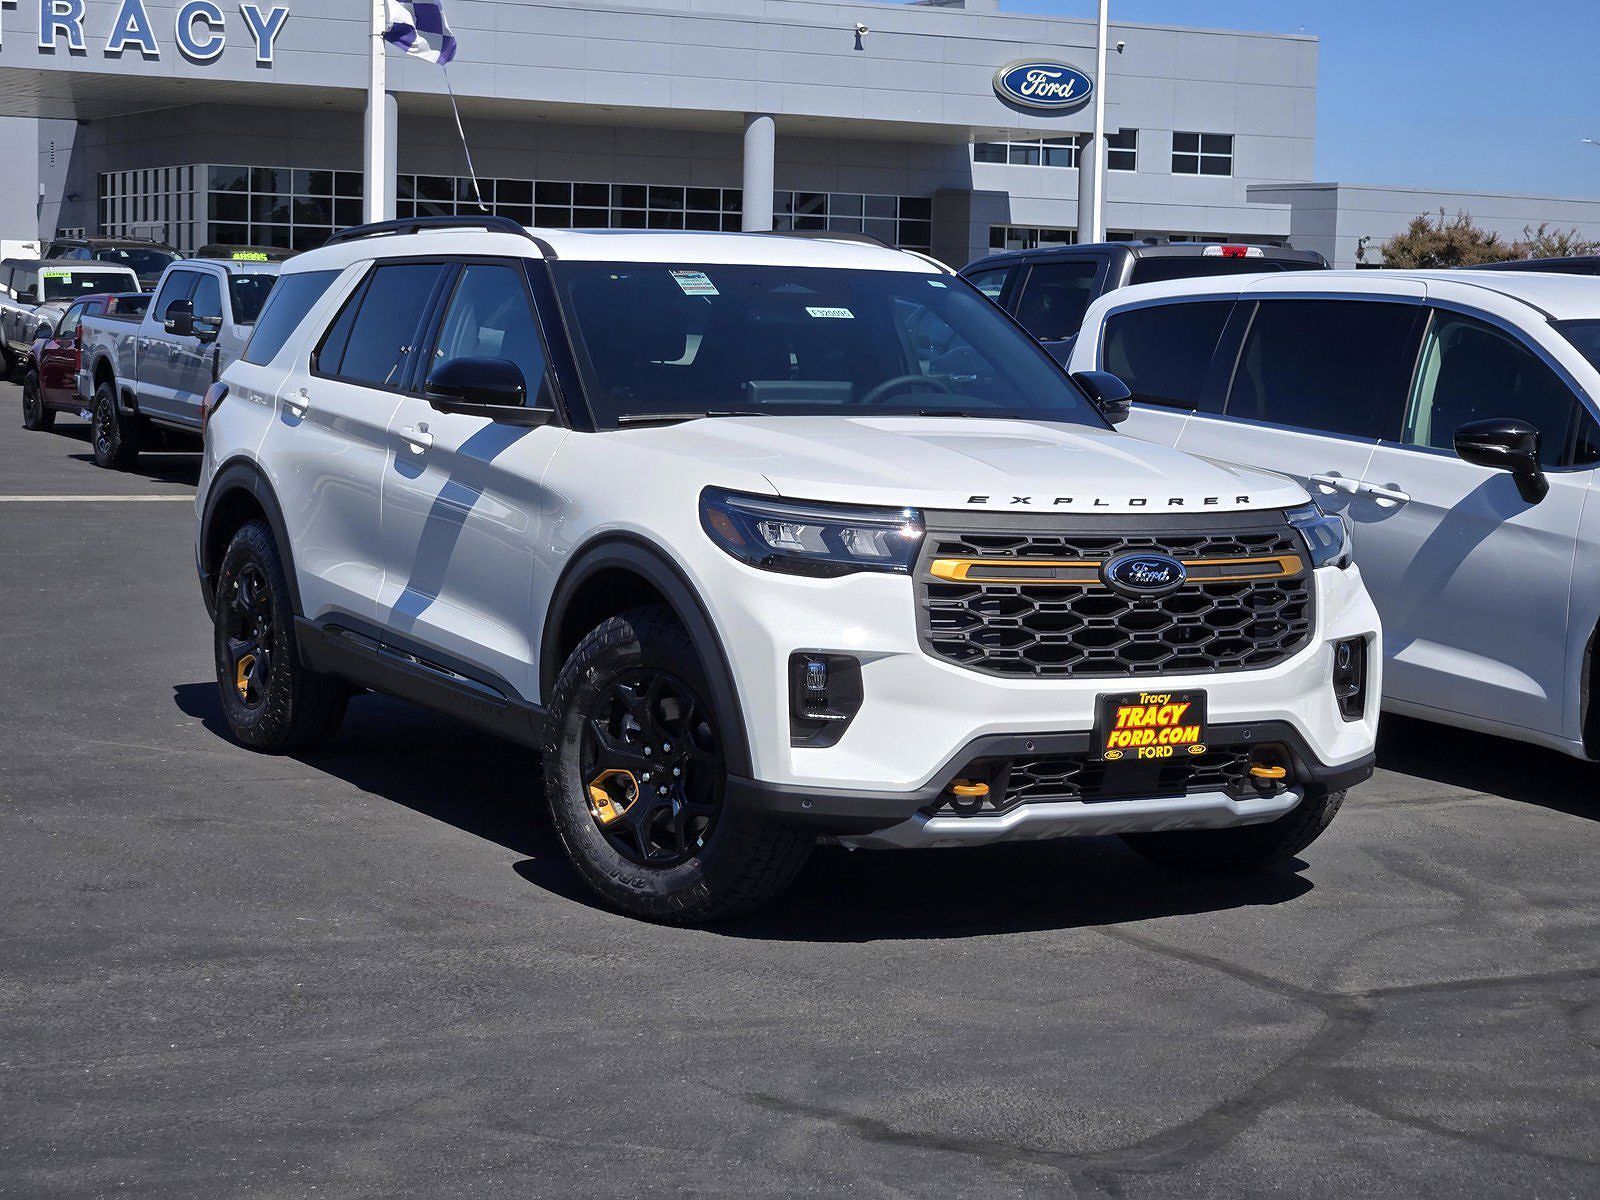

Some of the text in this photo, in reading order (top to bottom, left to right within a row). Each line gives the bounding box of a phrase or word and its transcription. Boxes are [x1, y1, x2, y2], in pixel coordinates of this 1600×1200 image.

[1020, 69, 1075, 98] Ford
[966, 495, 1251, 507] EXPLORER
[1128, 561, 1171, 582] Ford
[1139, 692, 1172, 705] Tracy
[1115, 703, 1191, 729] TRACY
[1107, 726, 1200, 748] FORD.COM
[1138, 745, 1174, 759] FORD
